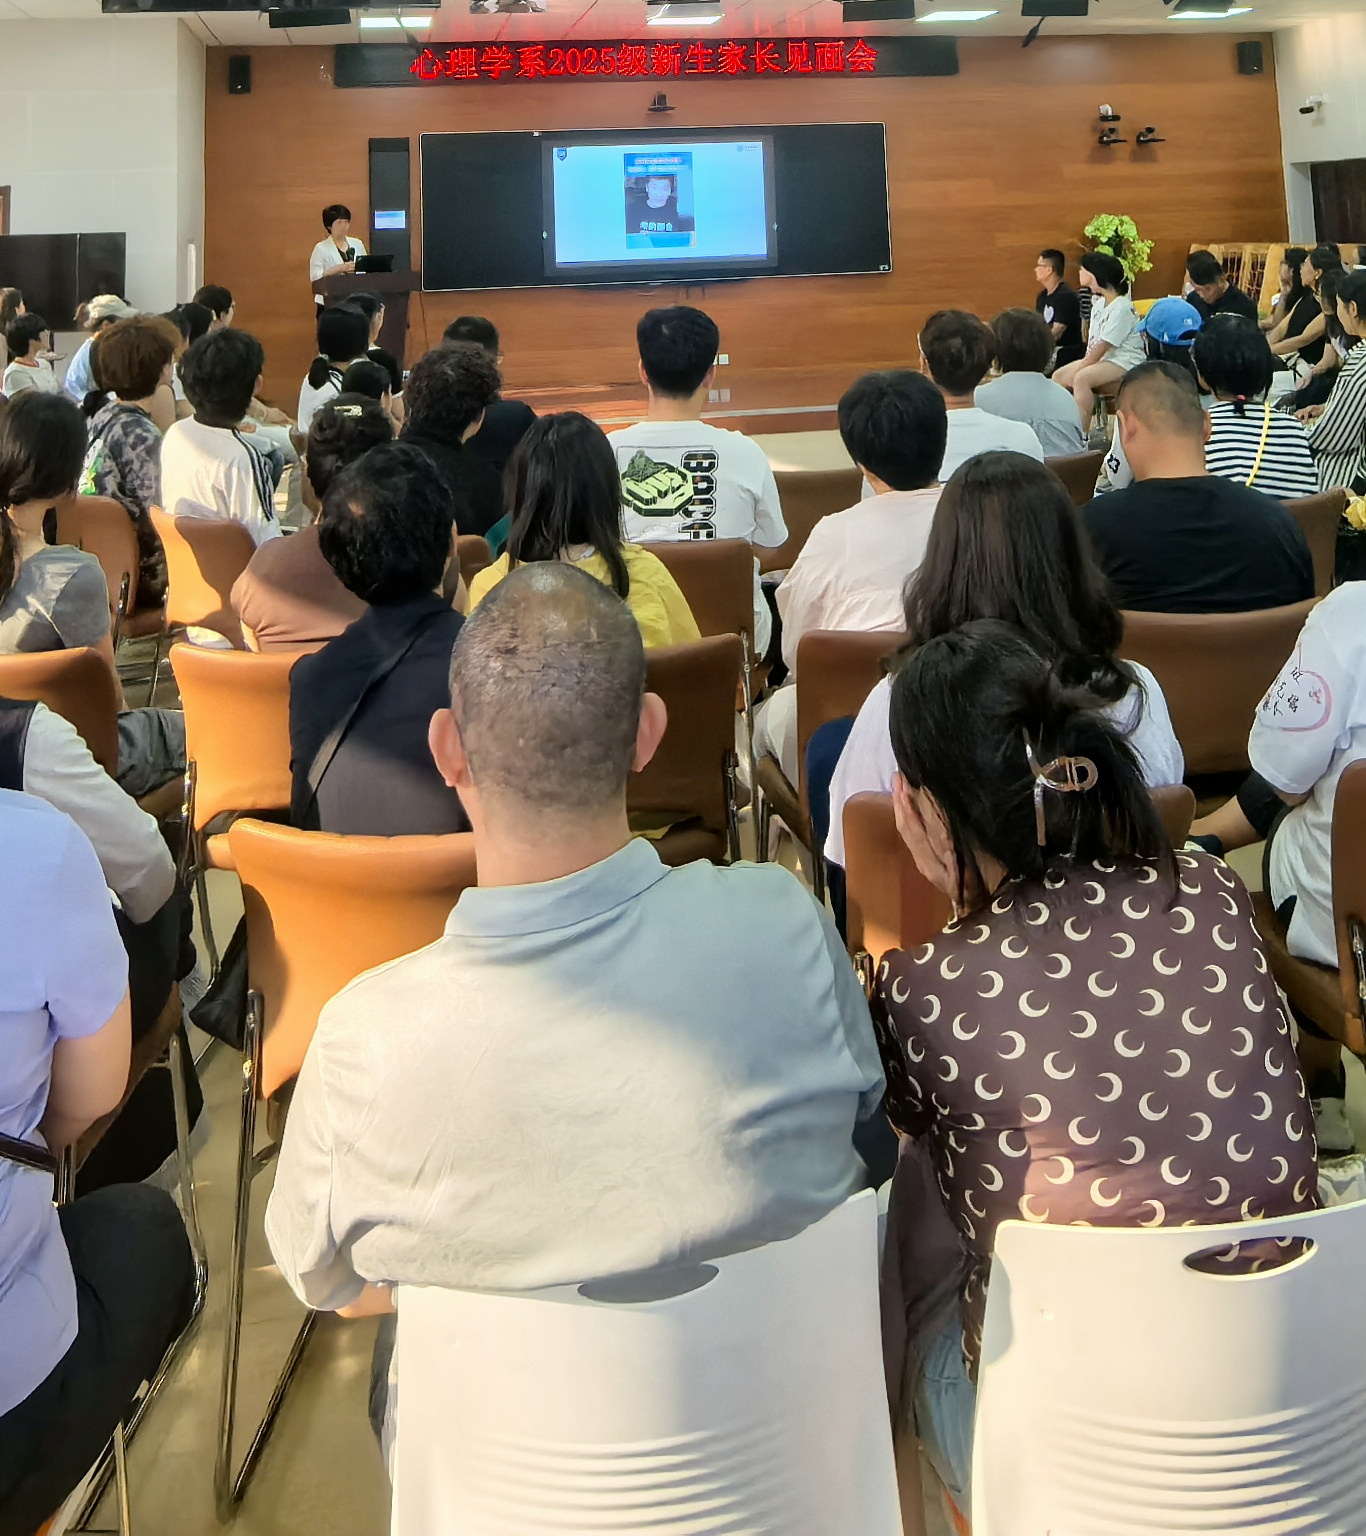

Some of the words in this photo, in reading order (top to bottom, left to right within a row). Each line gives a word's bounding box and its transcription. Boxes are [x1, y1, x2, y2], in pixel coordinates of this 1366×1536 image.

[409, 39, 878, 80] 心理学系2025级新生家长见面会
